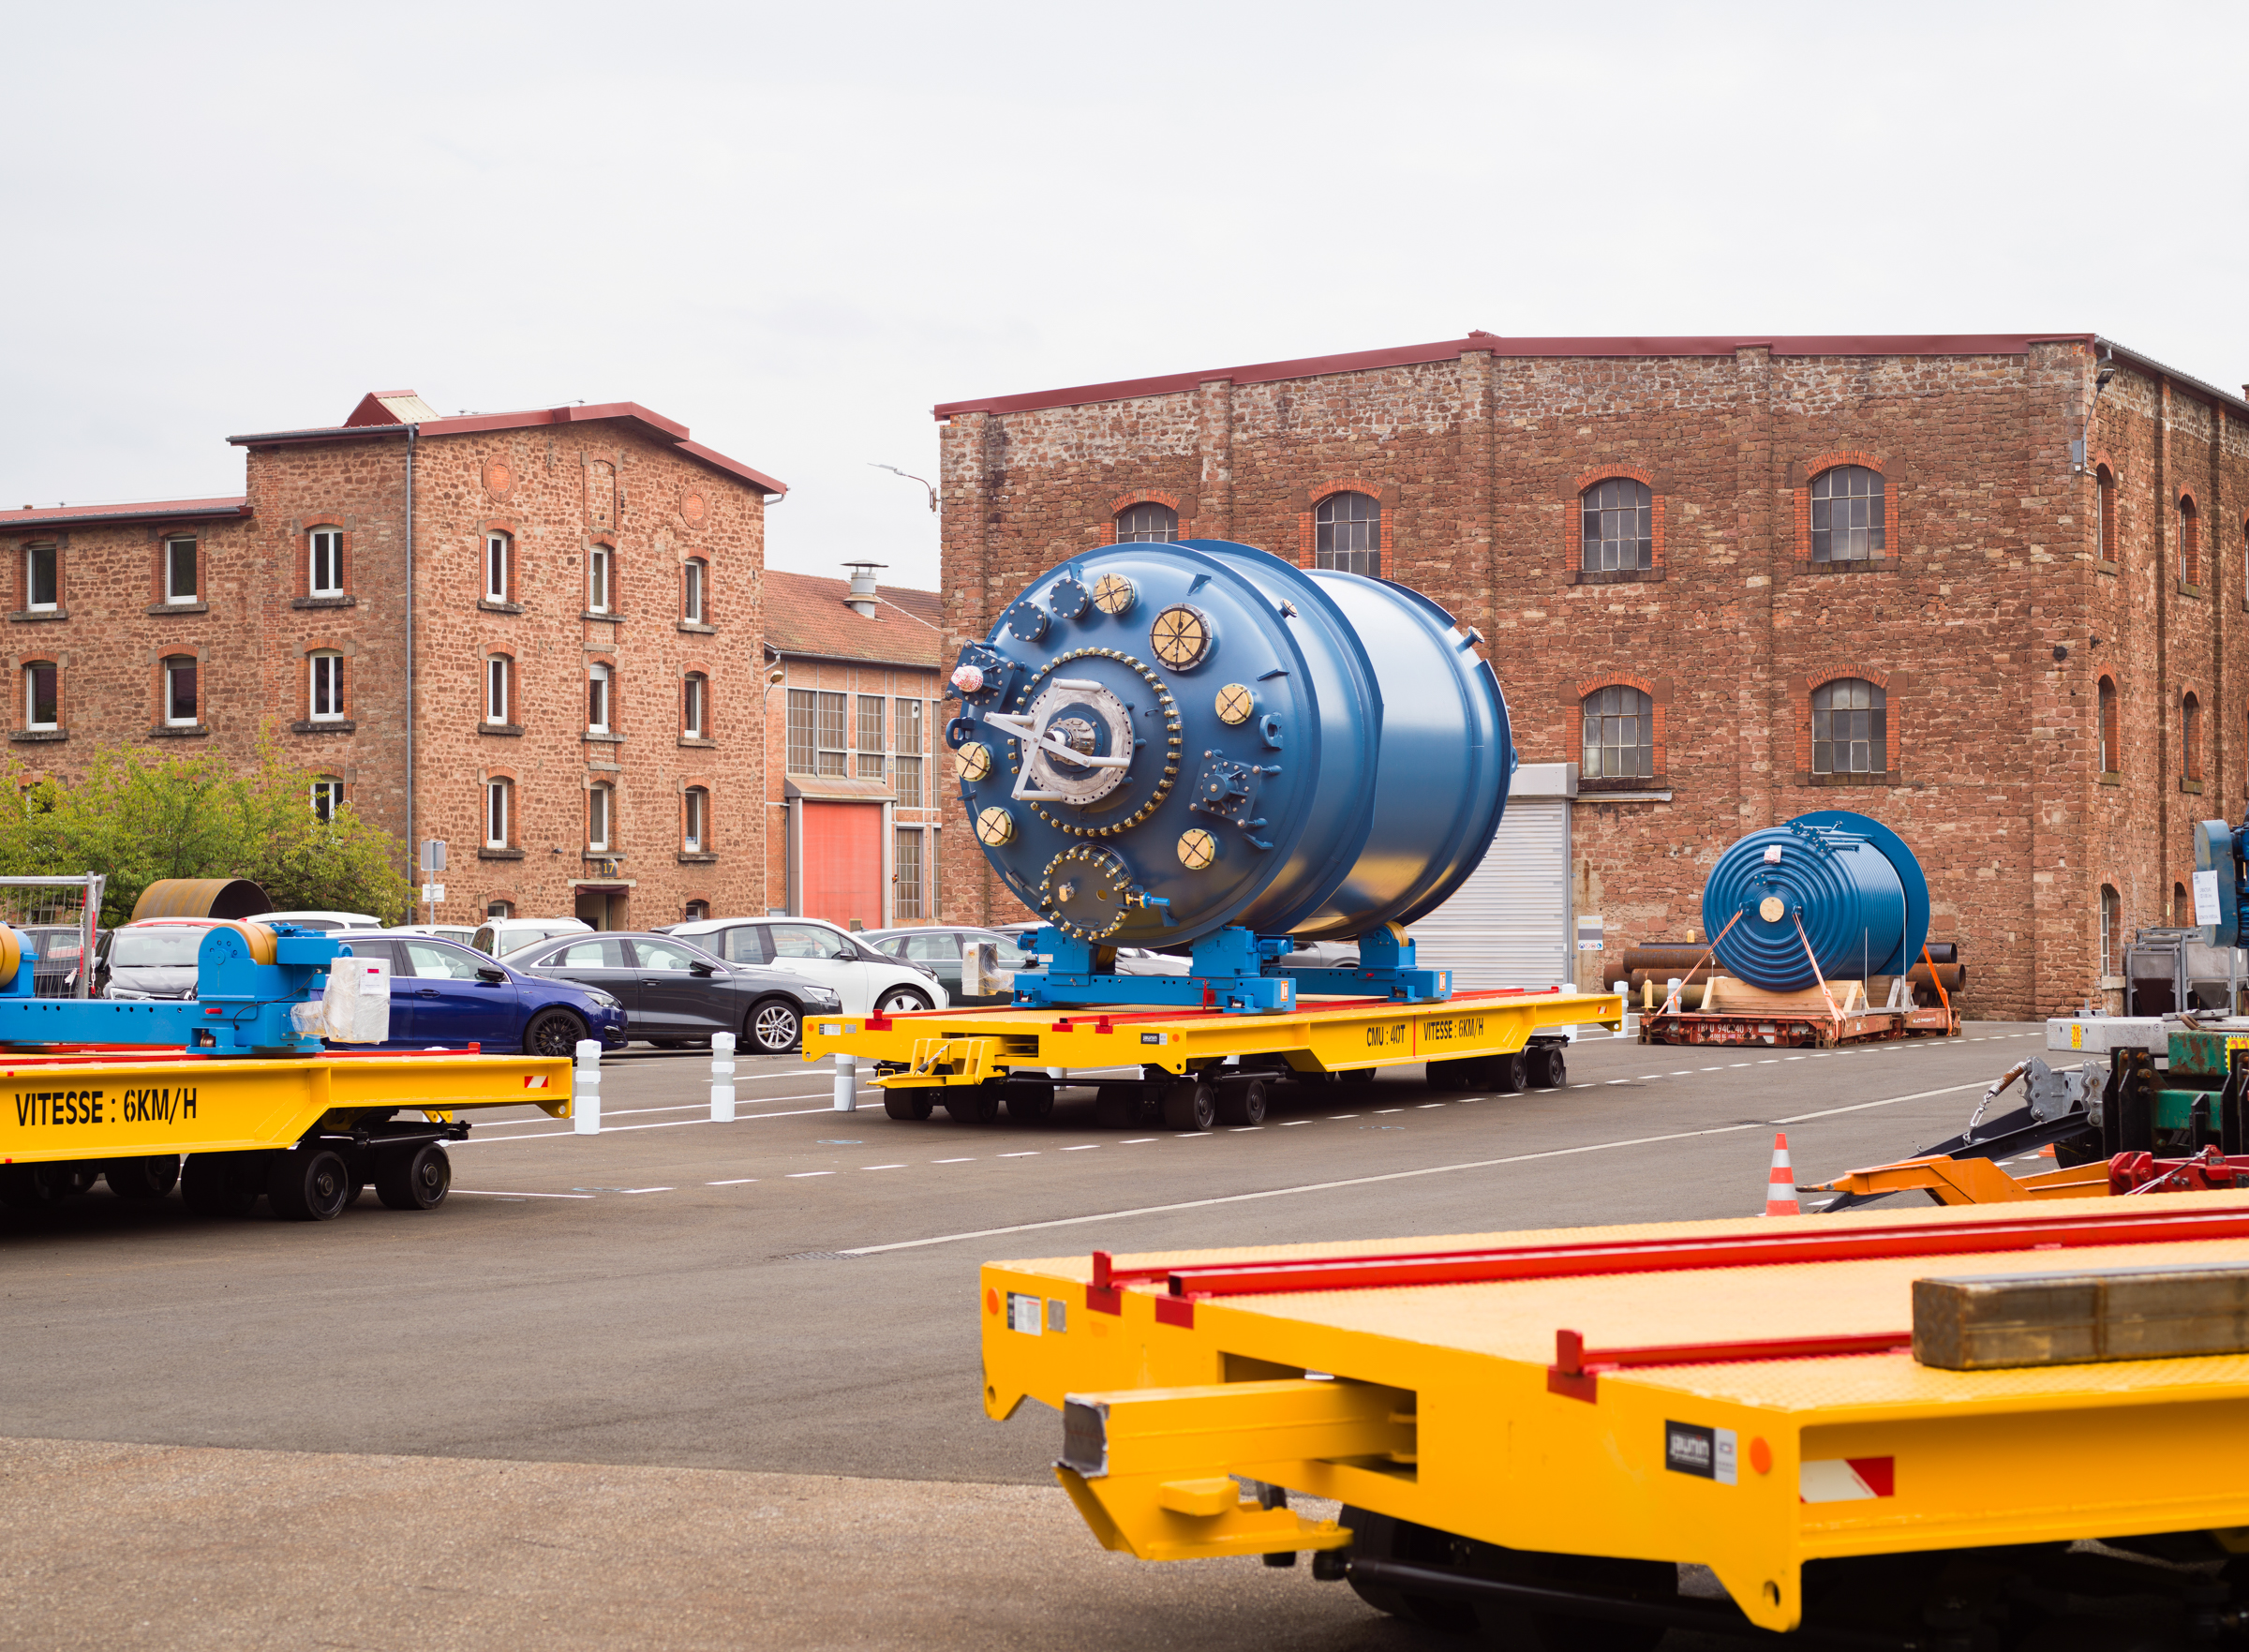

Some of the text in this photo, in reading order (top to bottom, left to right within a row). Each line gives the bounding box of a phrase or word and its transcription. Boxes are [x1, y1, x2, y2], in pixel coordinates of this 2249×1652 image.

[887, 761, 894, 770] 15
[603, 862, 615, 873] 17
[1366, 1026, 1384, 1047] CMU
[1391, 1024, 1406, 1045] 40T
[1423, 1020, 1452, 1041] VITESSE
[1459, 1018, 1483, 1039] 6KM/H
[2072, 1026, 2079, 1042] 28
[15, 1091, 103, 1126] VITESSE
[124, 1087, 197, 1125] 6KM/H
